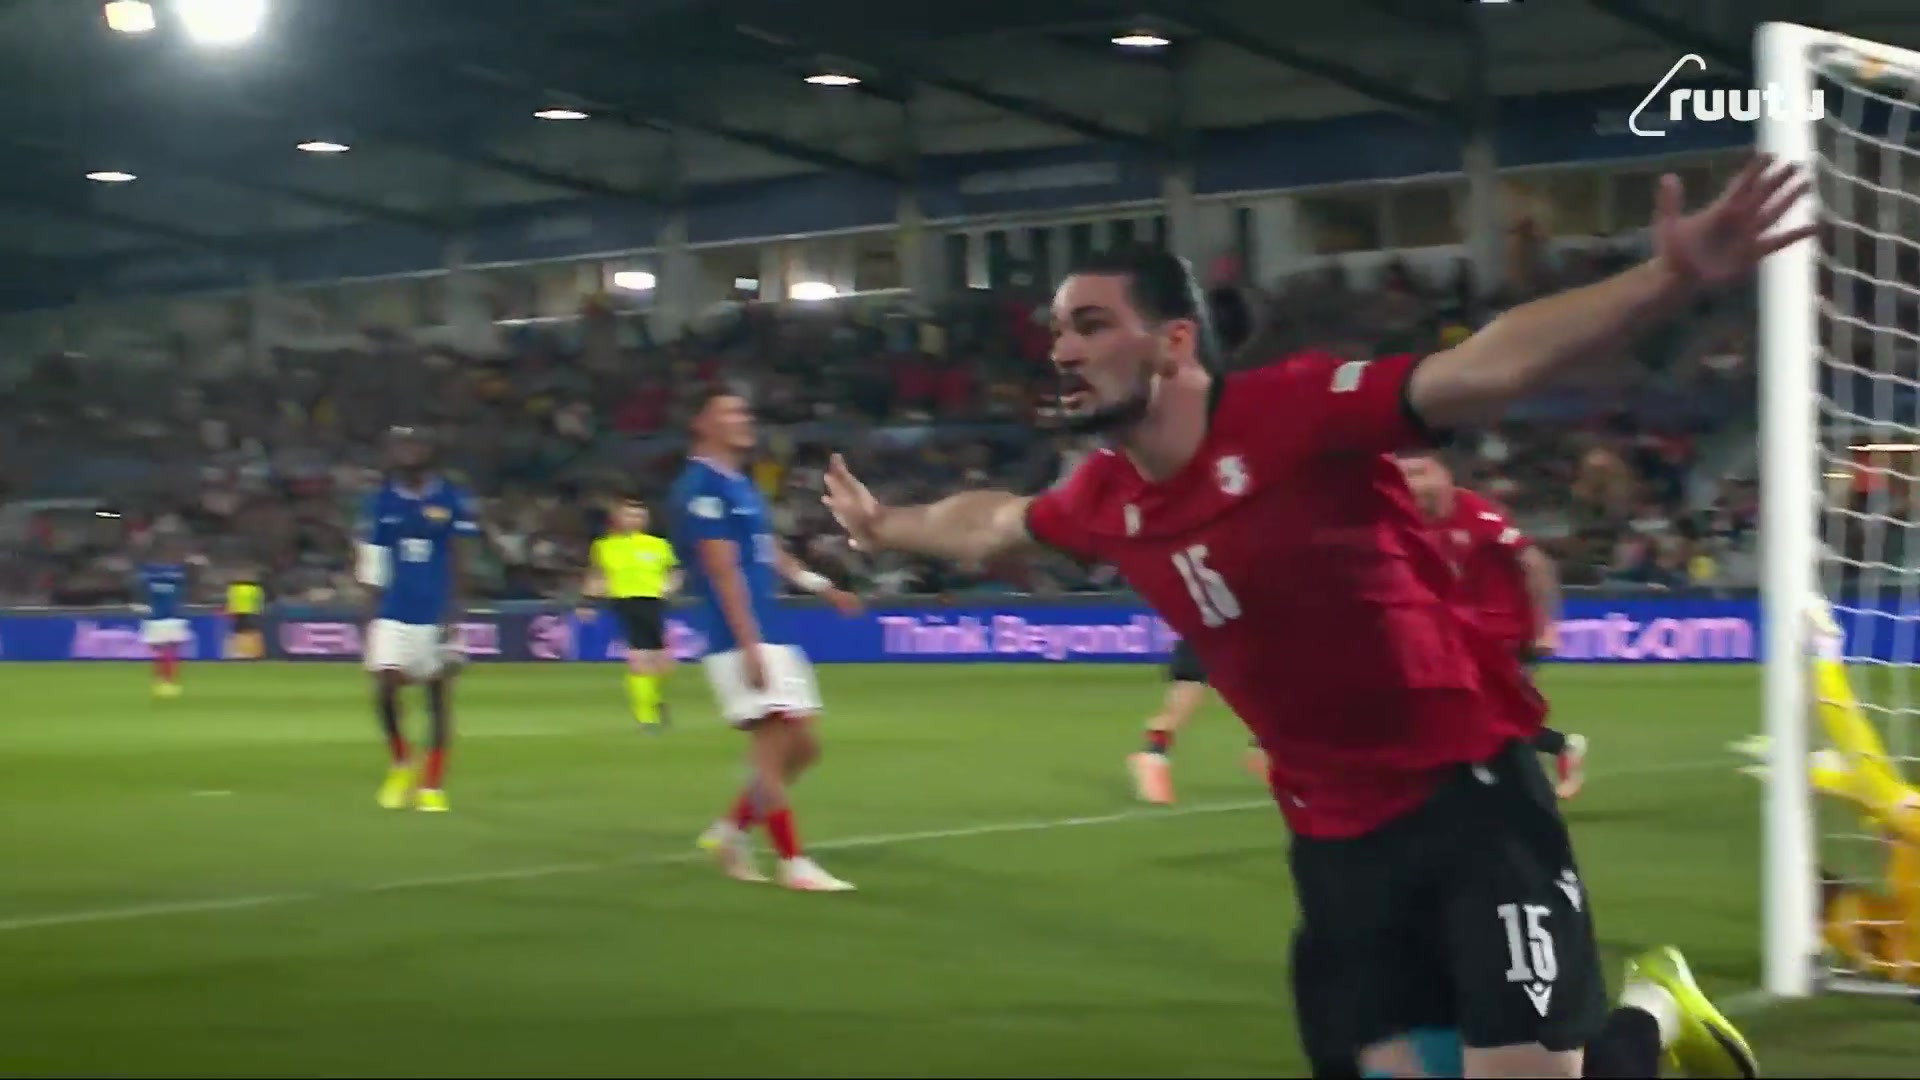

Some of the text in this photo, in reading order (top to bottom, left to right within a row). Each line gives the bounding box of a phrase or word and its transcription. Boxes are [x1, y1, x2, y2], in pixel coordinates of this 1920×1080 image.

[1171, 543, 1242, 628] 15
[877, 615, 989, 653] Think
[992, 614, 1149, 661] Beyond
[1497, 903, 1558, 982] 15
